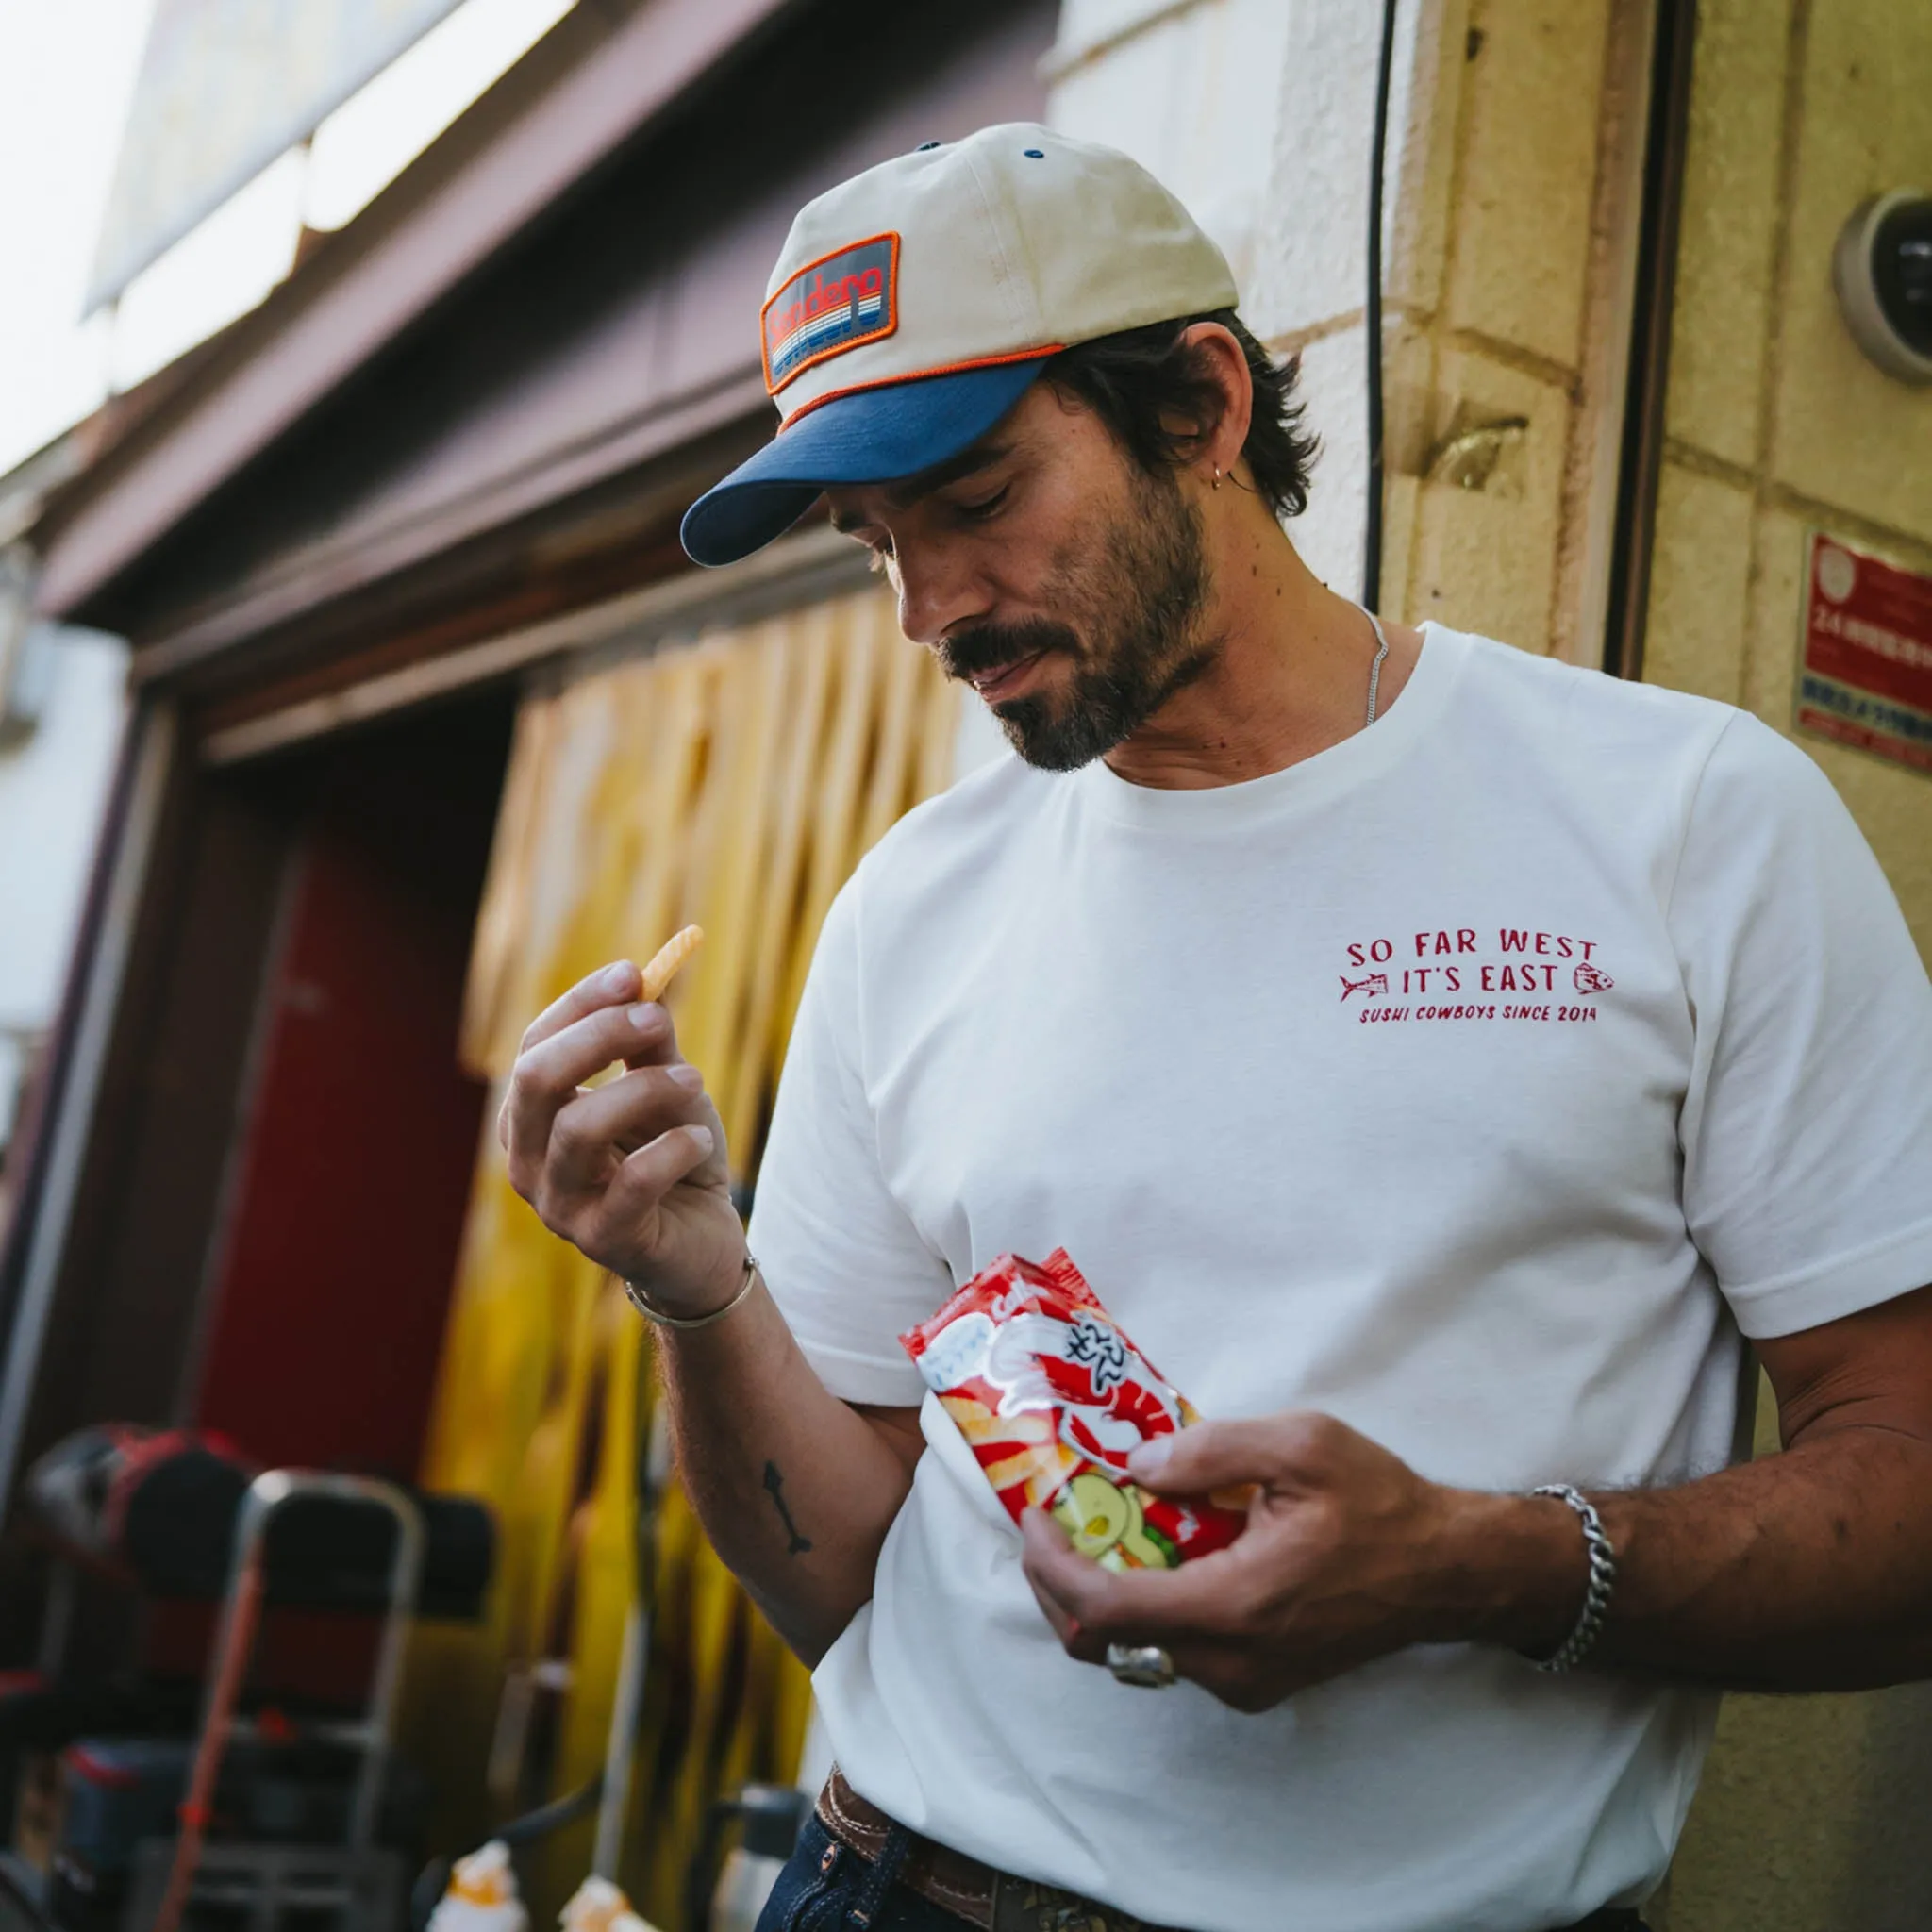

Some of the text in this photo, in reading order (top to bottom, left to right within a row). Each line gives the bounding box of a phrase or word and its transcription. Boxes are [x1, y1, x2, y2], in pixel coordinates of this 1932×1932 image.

[1347, 929, 1597, 966] SO FAR WEST
[1404, 964, 1557, 994] IT'S EAST
[1359, 1005, 1596, 1023] SUSHI COWBOYS SINCE 2014
